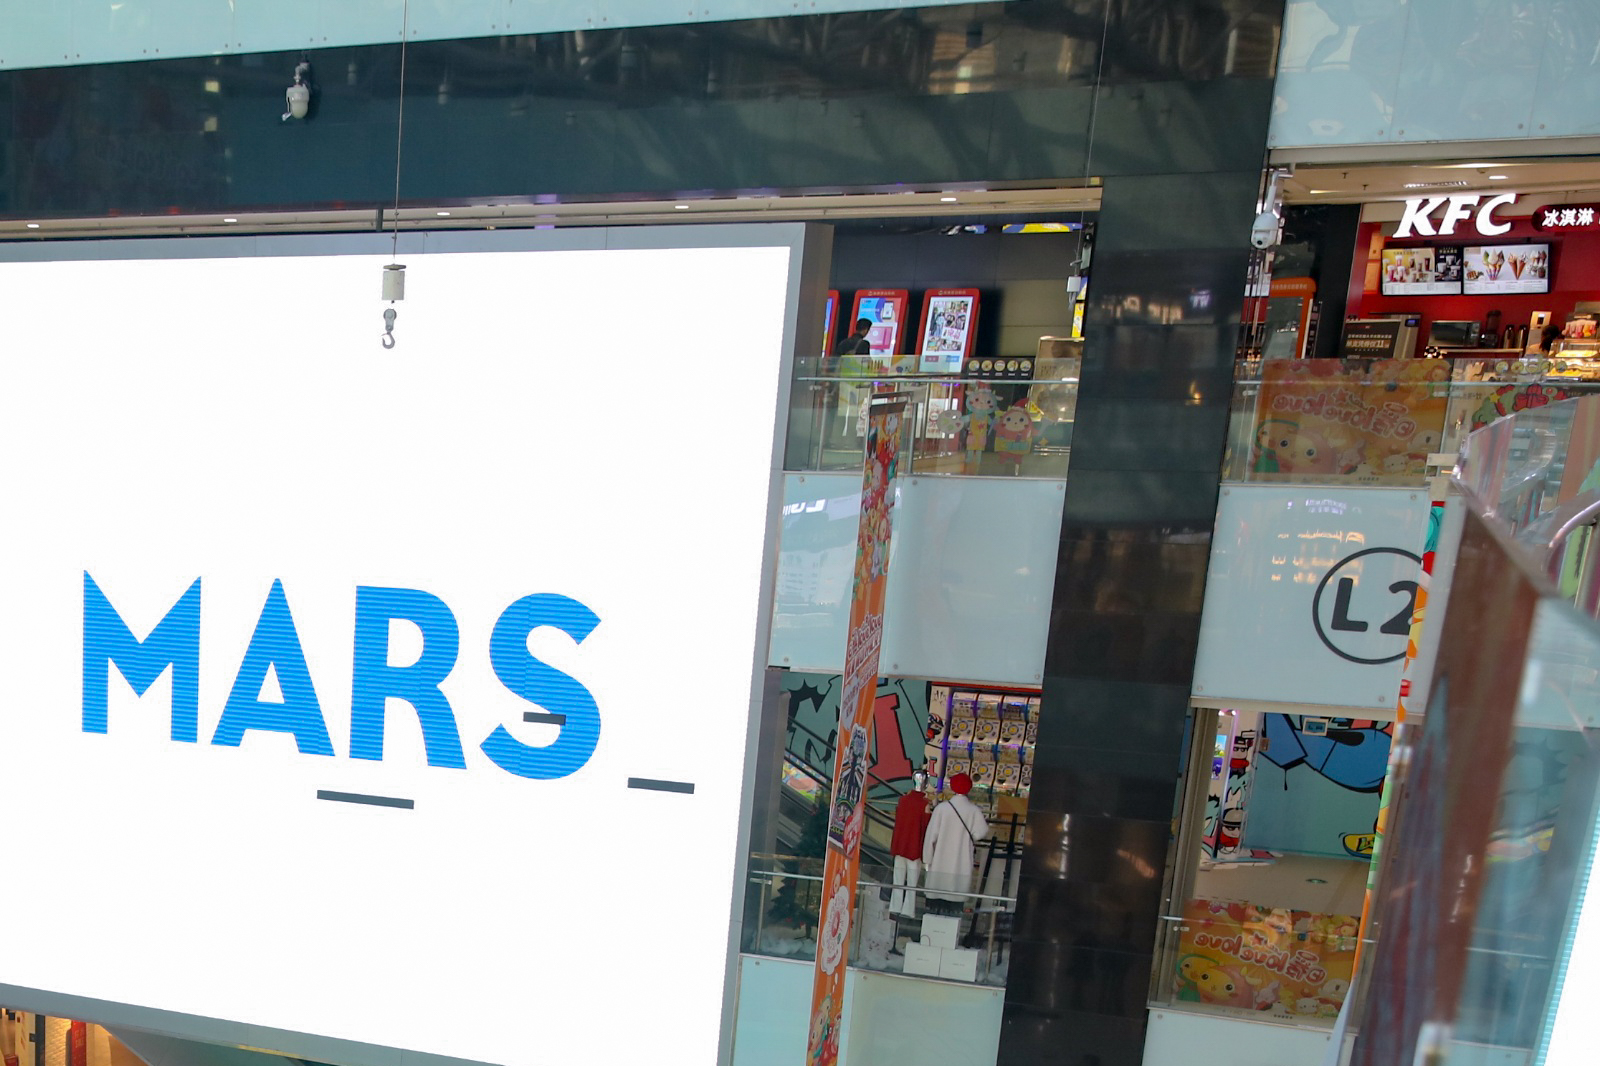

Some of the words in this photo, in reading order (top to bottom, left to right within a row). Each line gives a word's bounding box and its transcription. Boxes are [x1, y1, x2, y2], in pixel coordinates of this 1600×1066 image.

[1392, 193, 1516, 238] KFC
[1542, 207, 1595, 227] 冰淇淋
[1330, 578, 1418, 635] L2
[81, 569, 602, 781] MARS
